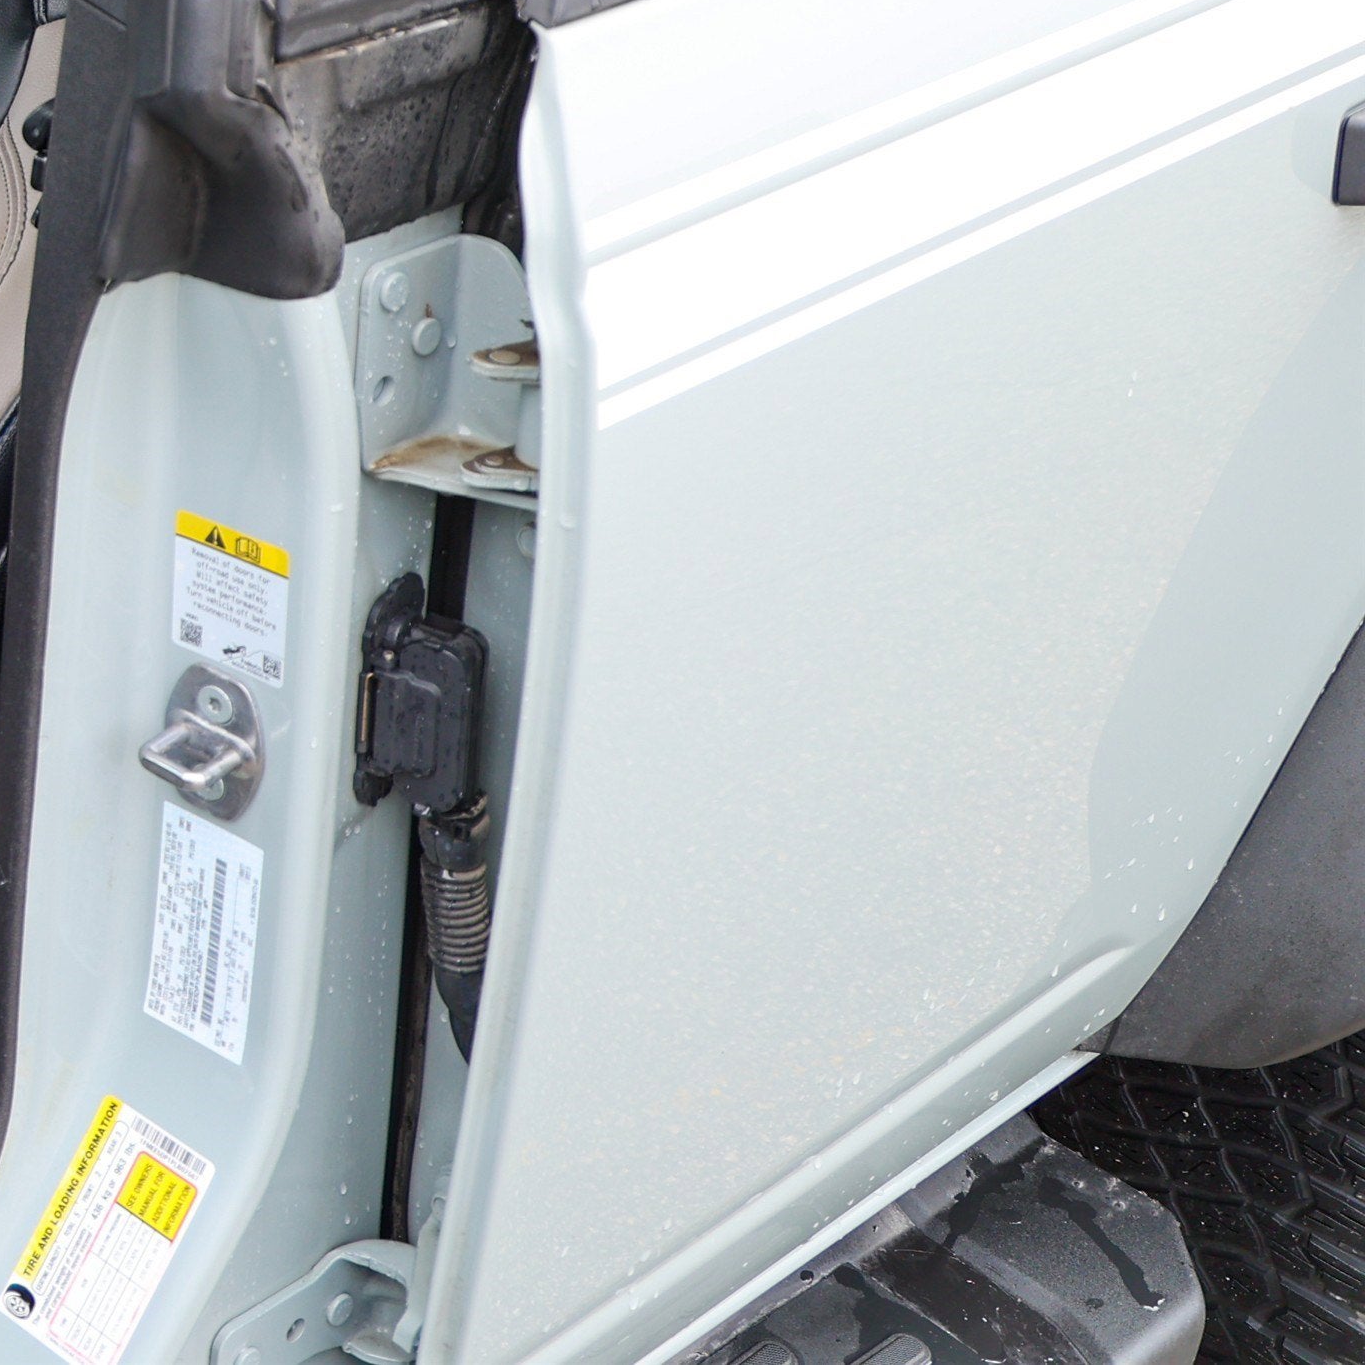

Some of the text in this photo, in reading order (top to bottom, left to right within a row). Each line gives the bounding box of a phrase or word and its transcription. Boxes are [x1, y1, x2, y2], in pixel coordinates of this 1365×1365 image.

[191, 545, 270, 586] Removal of doors for
[191, 578, 216, 596] system
[196, 559, 229, 579] off-road
[231, 575, 244, 585] use
[186, 585, 277, 631] Turn vehicle off before
[195, 568, 212, 583] Will
[243, 589, 269, 609] safety
[192, 599, 241, 628] reconnecting
[22, 1100, 119, 1278] TIRE AND LOADING INFORMATION
[89, 1201, 104, 1222] 436
[99, 1187, 113, 1202] kg
[107, 1178, 117, 1190] or
[112, 1156, 128, 1176] 963
[125, 1192, 138, 1209] SEE
[132, 1161, 154, 1194] OWNERS
[137, 1185, 158, 1217] MANUAL
[152, 1169, 166, 1187] FOR
[150, 1179, 177, 1224] ADDITIONAL
[162, 1183, 192, 1234] INFORMATION
